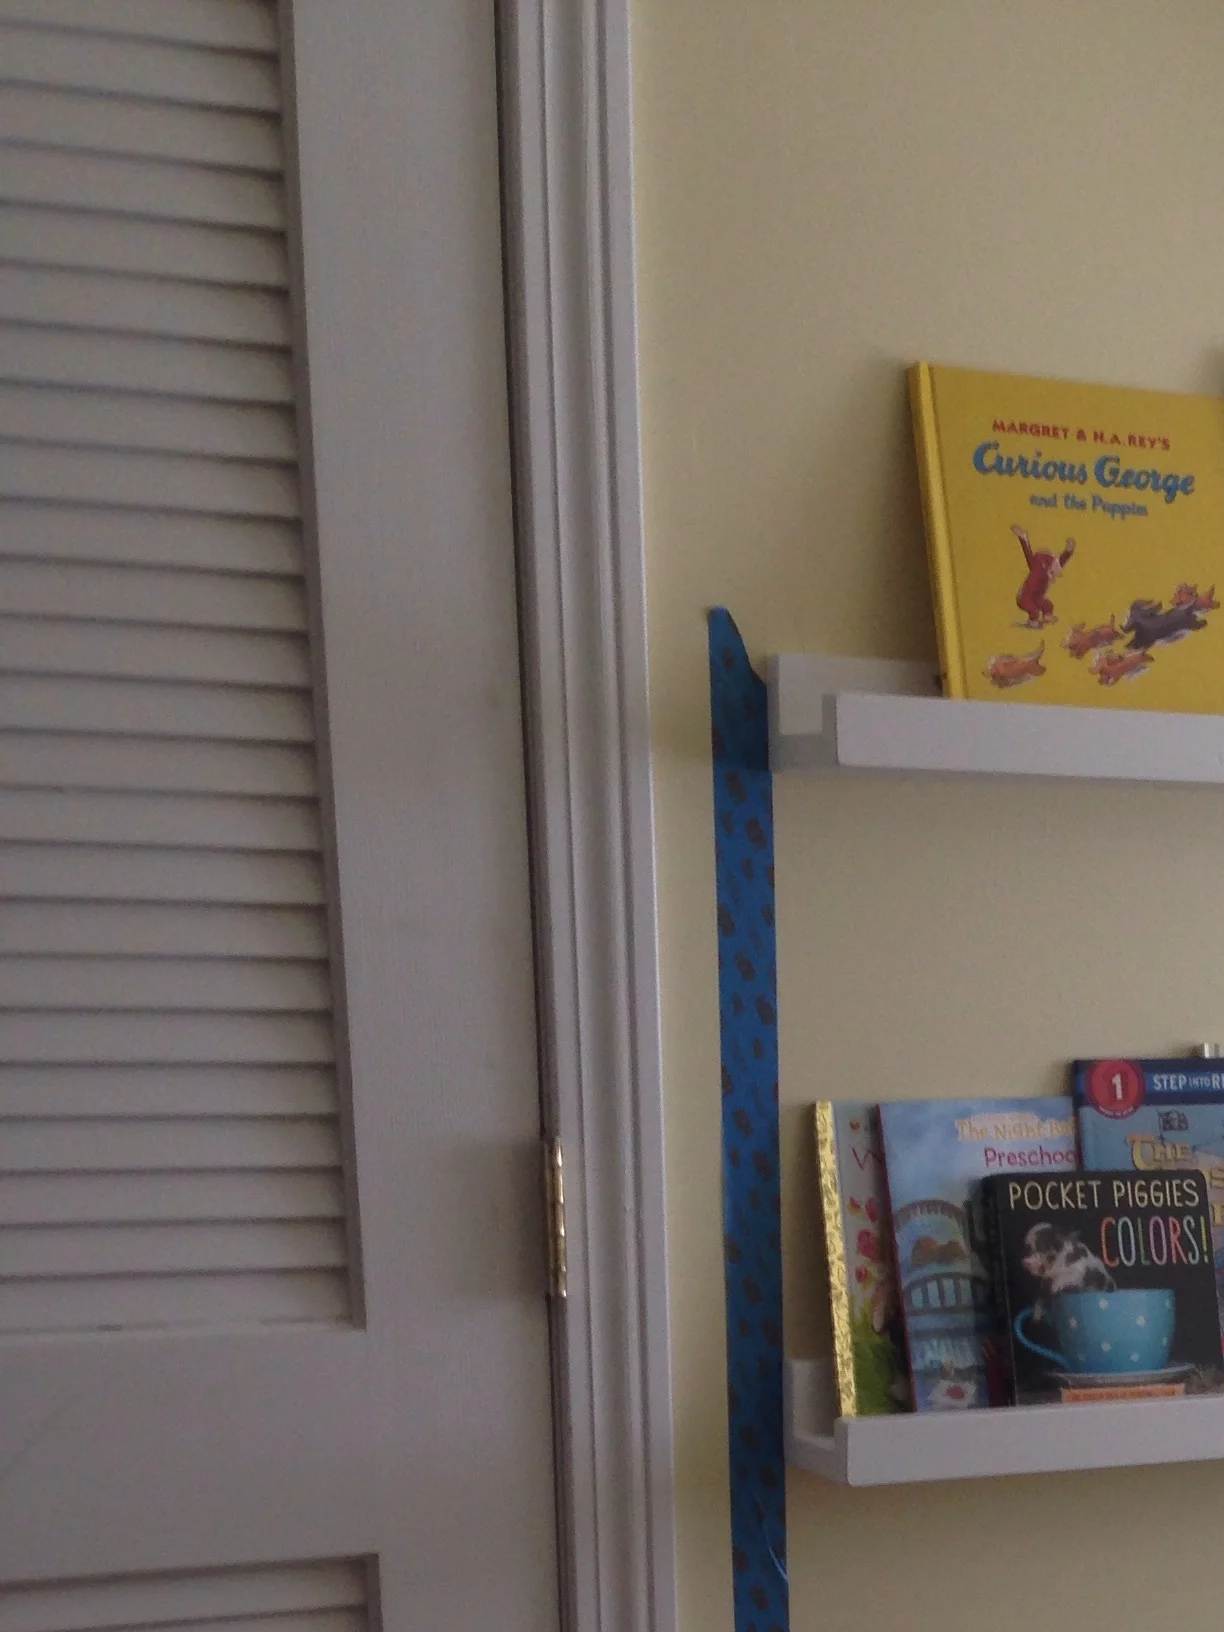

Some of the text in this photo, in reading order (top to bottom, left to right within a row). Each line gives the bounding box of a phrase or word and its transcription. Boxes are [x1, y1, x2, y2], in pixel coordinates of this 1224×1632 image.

[992, 419, 1070, 440] MARGRET
[1077, 428, 1087, 442] &
[973, 441, 1196, 504] Curious George
[1064, 494, 1087, 511] the
[1111, 1072, 1124, 1101] 1
[1152, 1072, 1188, 1091] STEP
[1188, 1075, 1212, 1087] INTO
[984, 1143, 1077, 1169] Preschoo
[1008, 1178, 1200, 1212] POCKET PIGGIES
[1101, 1214, 1210, 1268] COLORS!
